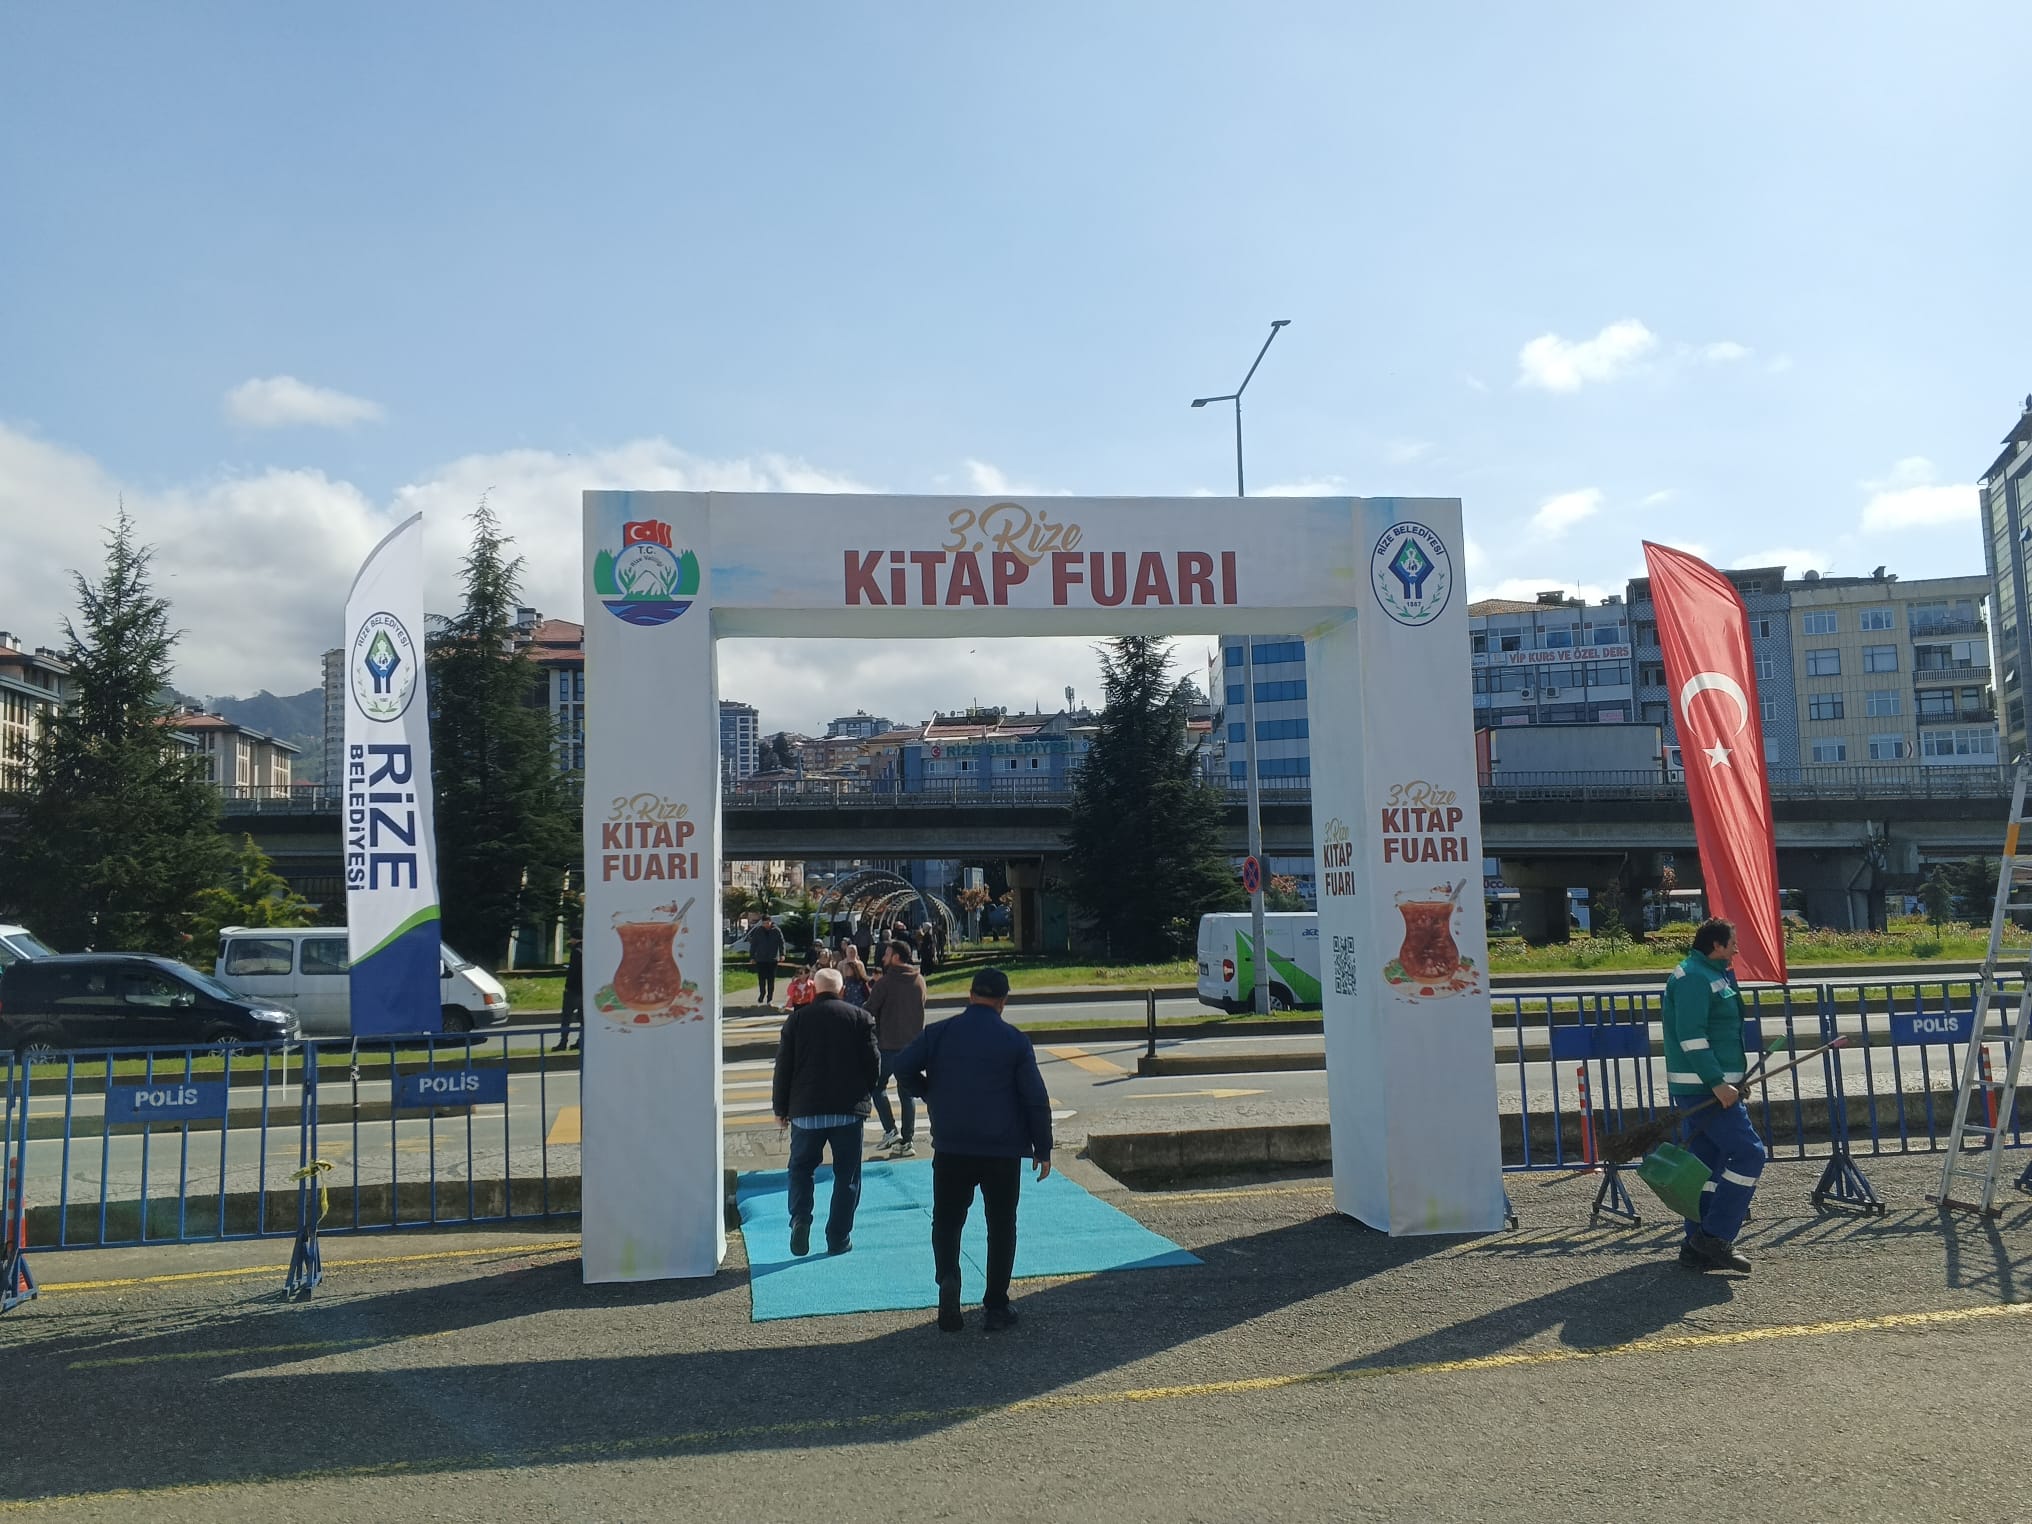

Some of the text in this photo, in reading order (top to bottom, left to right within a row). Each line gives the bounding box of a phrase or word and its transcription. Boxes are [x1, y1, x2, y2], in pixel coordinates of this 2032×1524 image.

[978, 502, 1083, 566] Rize
[1052, 550, 1238, 607] FUARI
[1509, 646, 1630, 664] VİP KURS VE ÖZEL DERS
[629, 792, 688, 827] Rize
[1404, 780, 1457, 814] Rize
[347, 744, 366, 891] BELEDİYESİ
[367, 744, 418, 890] RİZE
[1383, 836, 1469, 863] FUARI
[602, 852, 699, 882] FUARI
[1325, 871, 1356, 896] FUARI
[1913, 1015, 1959, 1033] POLİS
[135, 1085, 198, 1107] POLİS
[419, 1071, 480, 1093] POLİS
